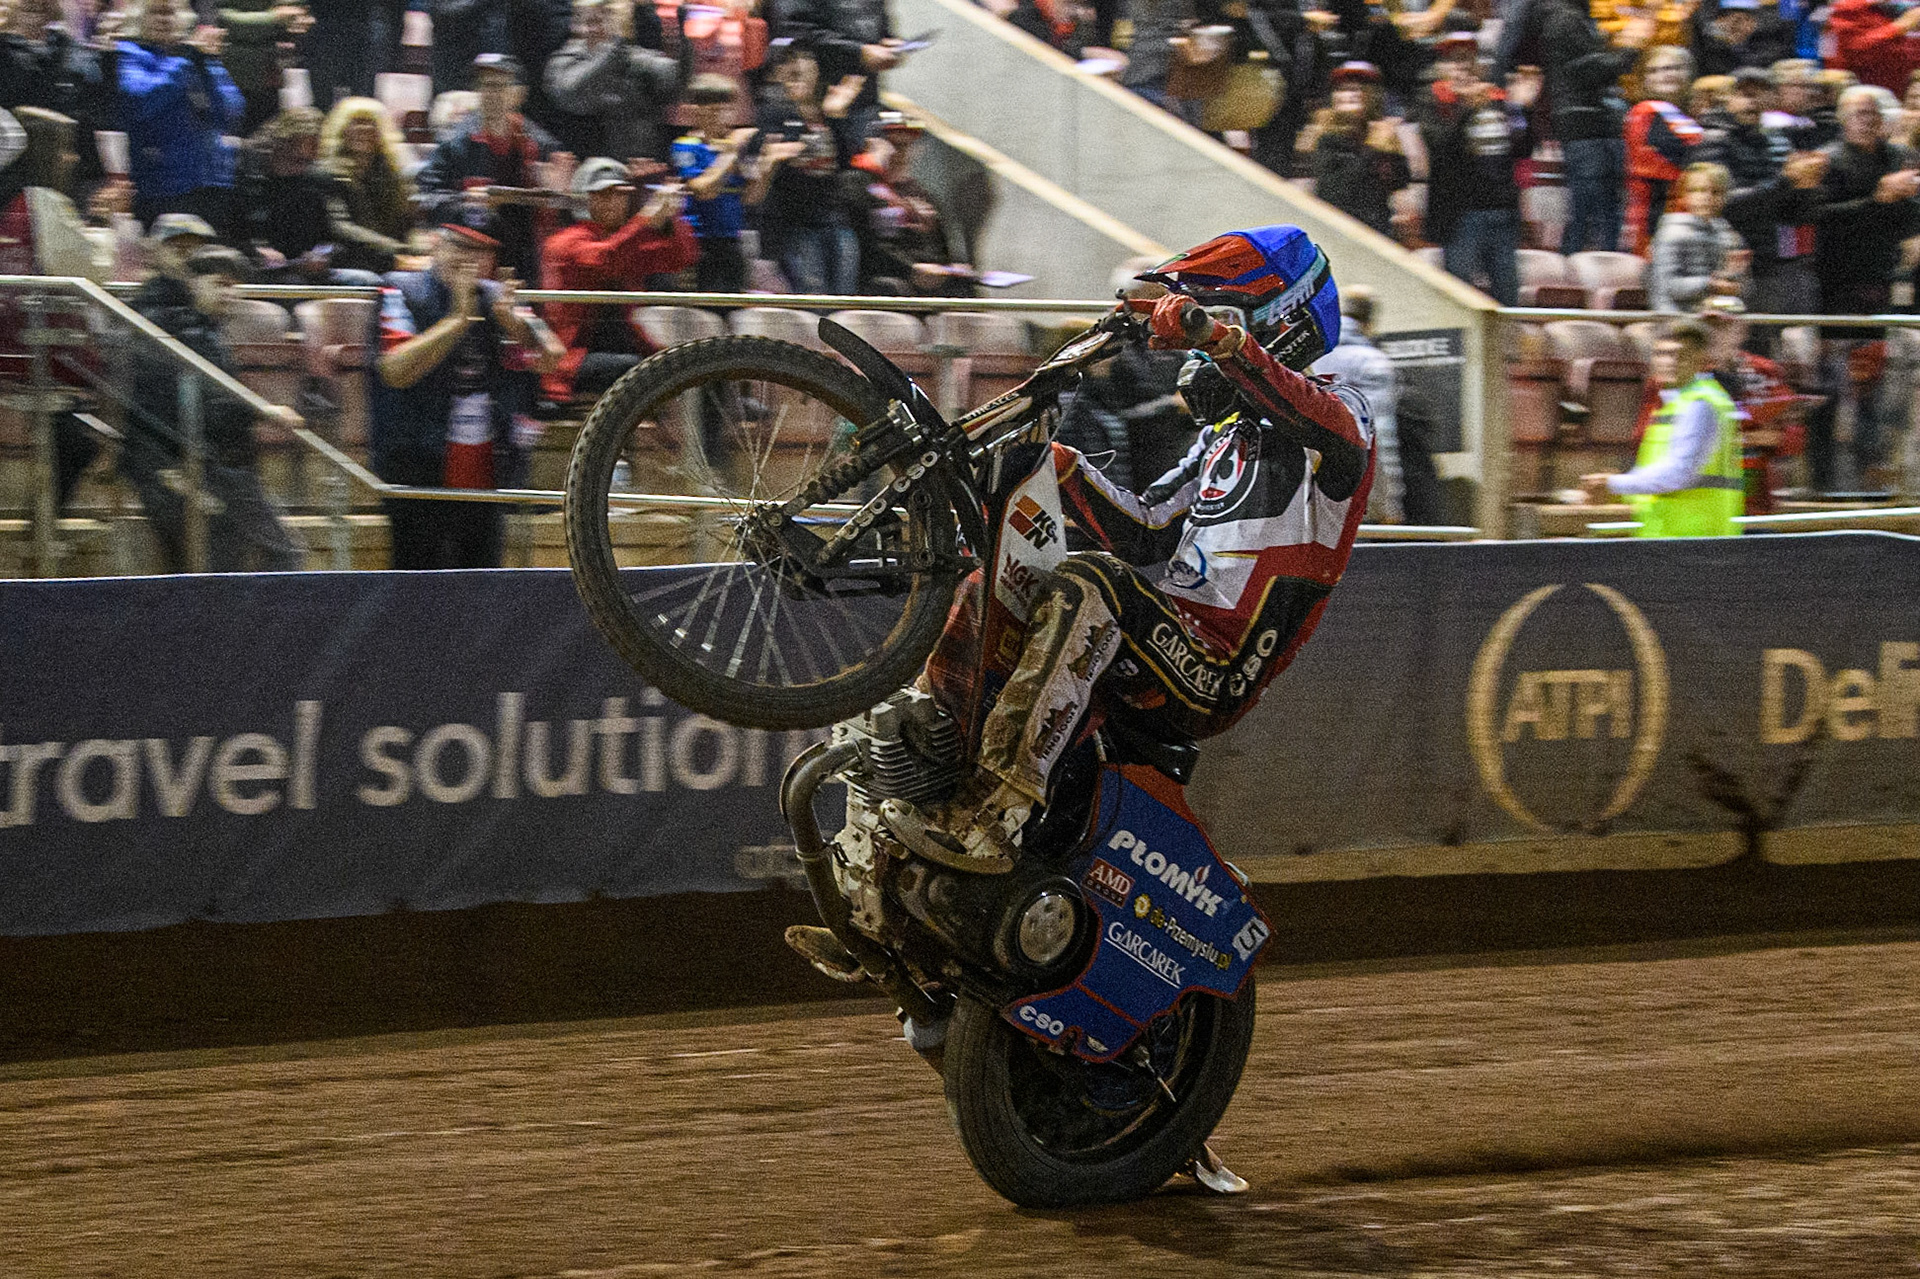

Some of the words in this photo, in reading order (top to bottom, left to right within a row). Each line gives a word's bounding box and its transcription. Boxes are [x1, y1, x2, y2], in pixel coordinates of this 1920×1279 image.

[1003, 553, 1039, 598] NGK
[1090, 864, 1131, 896] AMD
[1107, 921, 1187, 986] GARCAREK
